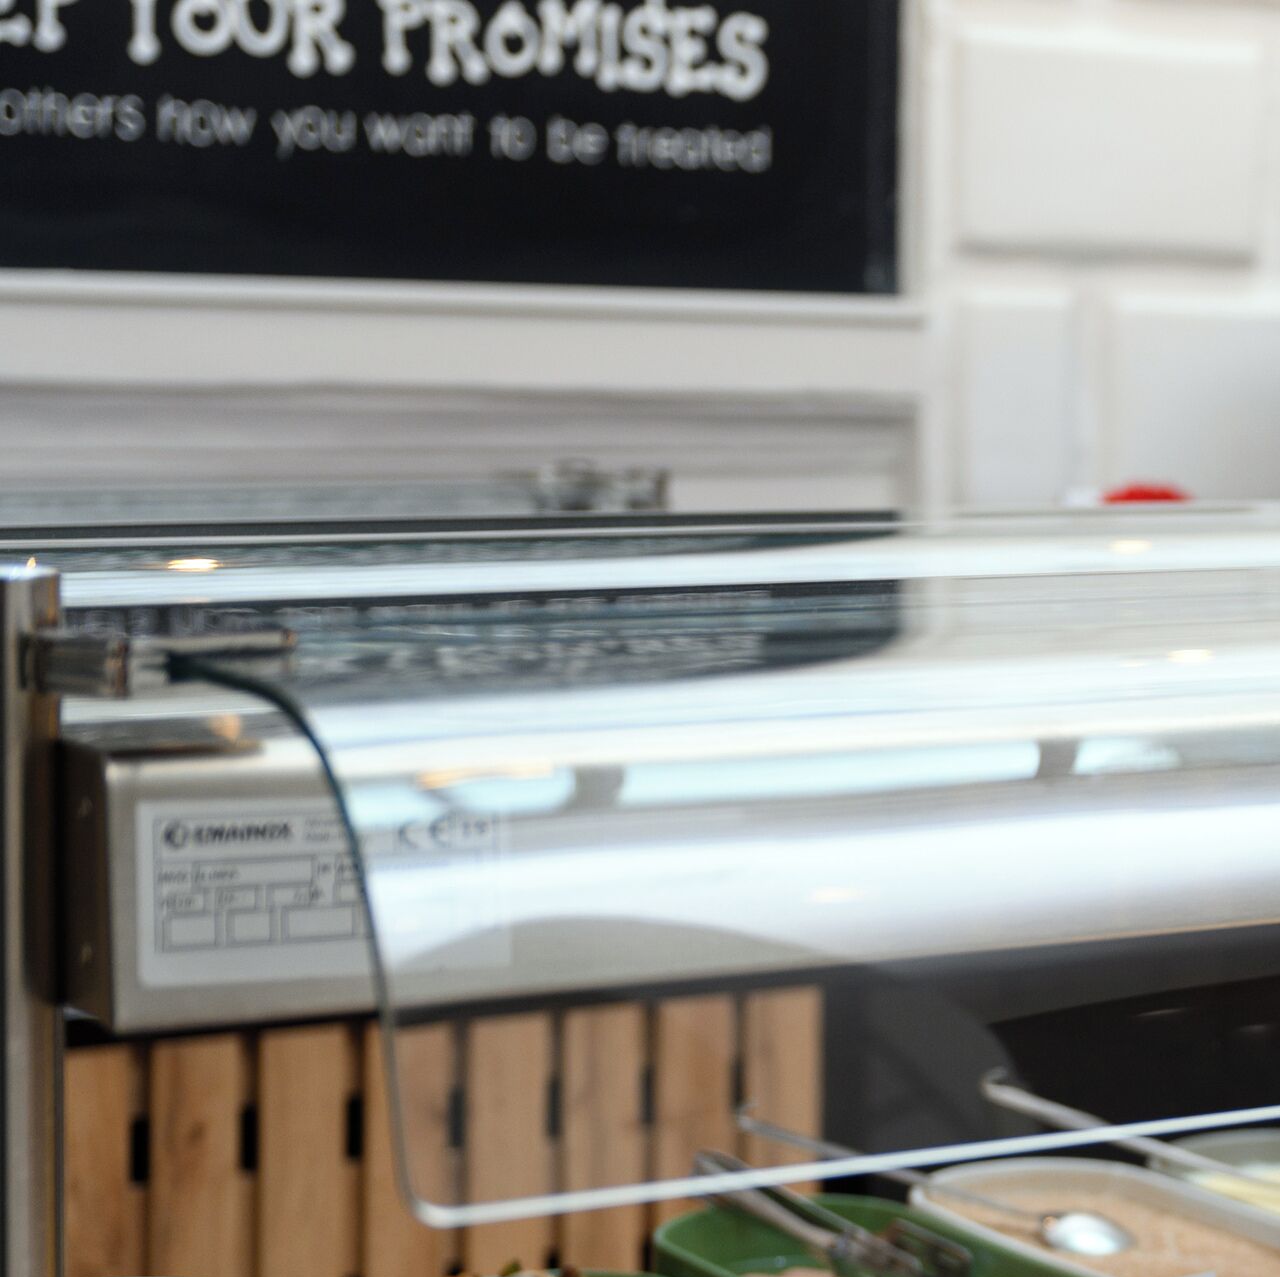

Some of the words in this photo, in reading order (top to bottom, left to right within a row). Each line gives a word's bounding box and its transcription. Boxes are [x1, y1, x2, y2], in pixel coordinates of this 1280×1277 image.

[378, 0, 770, 100] PROMISES
[156, 93, 257, 147] how
[271, 105, 356, 160] you
[363, 109, 476, 157] want
[491, 111, 537, 161] to
[546, 113, 609, 165] be
[615, 121, 773, 173] treated
